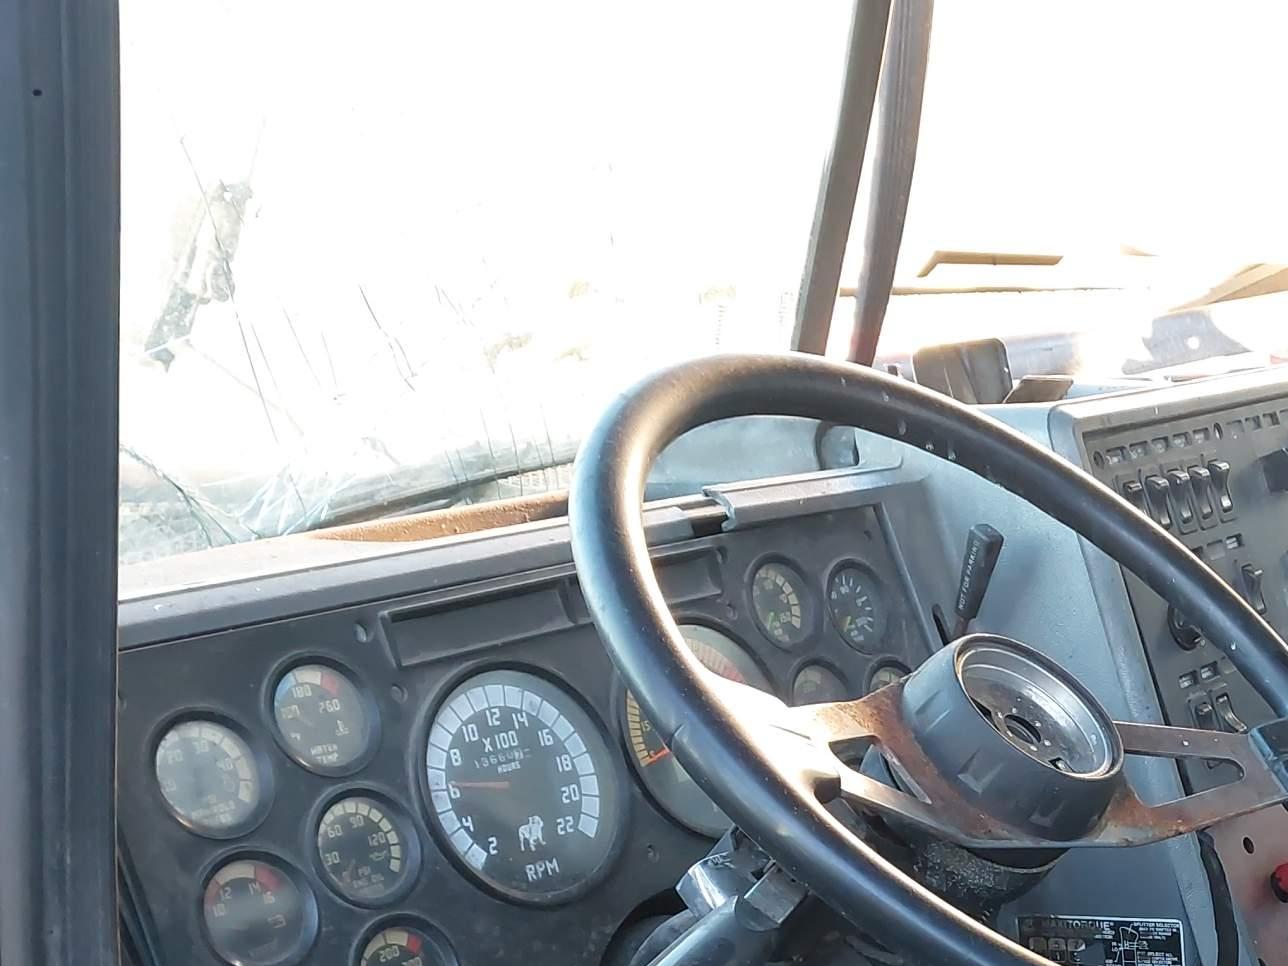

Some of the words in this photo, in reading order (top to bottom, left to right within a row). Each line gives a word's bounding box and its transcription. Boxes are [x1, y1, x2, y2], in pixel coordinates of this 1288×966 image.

[320, 699, 340, 713] 260
[486, 709, 500, 726] 12
[512, 712, 528, 729] 14
[463, 723, 479, 742] 10
[538, 729, 553, 746] 16
[450, 749, 462, 766] 8
[556, 754, 572, 772] 18
[498, 761, 521, 774] HOURS
[449, 783, 461, 799] 6
[561, 784, 580, 803] 20
[328, 825, 343, 838] 60
[462, 816, 474, 832] 4
[557, 816, 574, 835] 22
[368, 832, 386, 847] 120
[488, 837, 498, 855] 2
[325, 852, 340, 866] 30
[525, 858, 560, 882] RPM
[380, 945, 400, 962] 200
